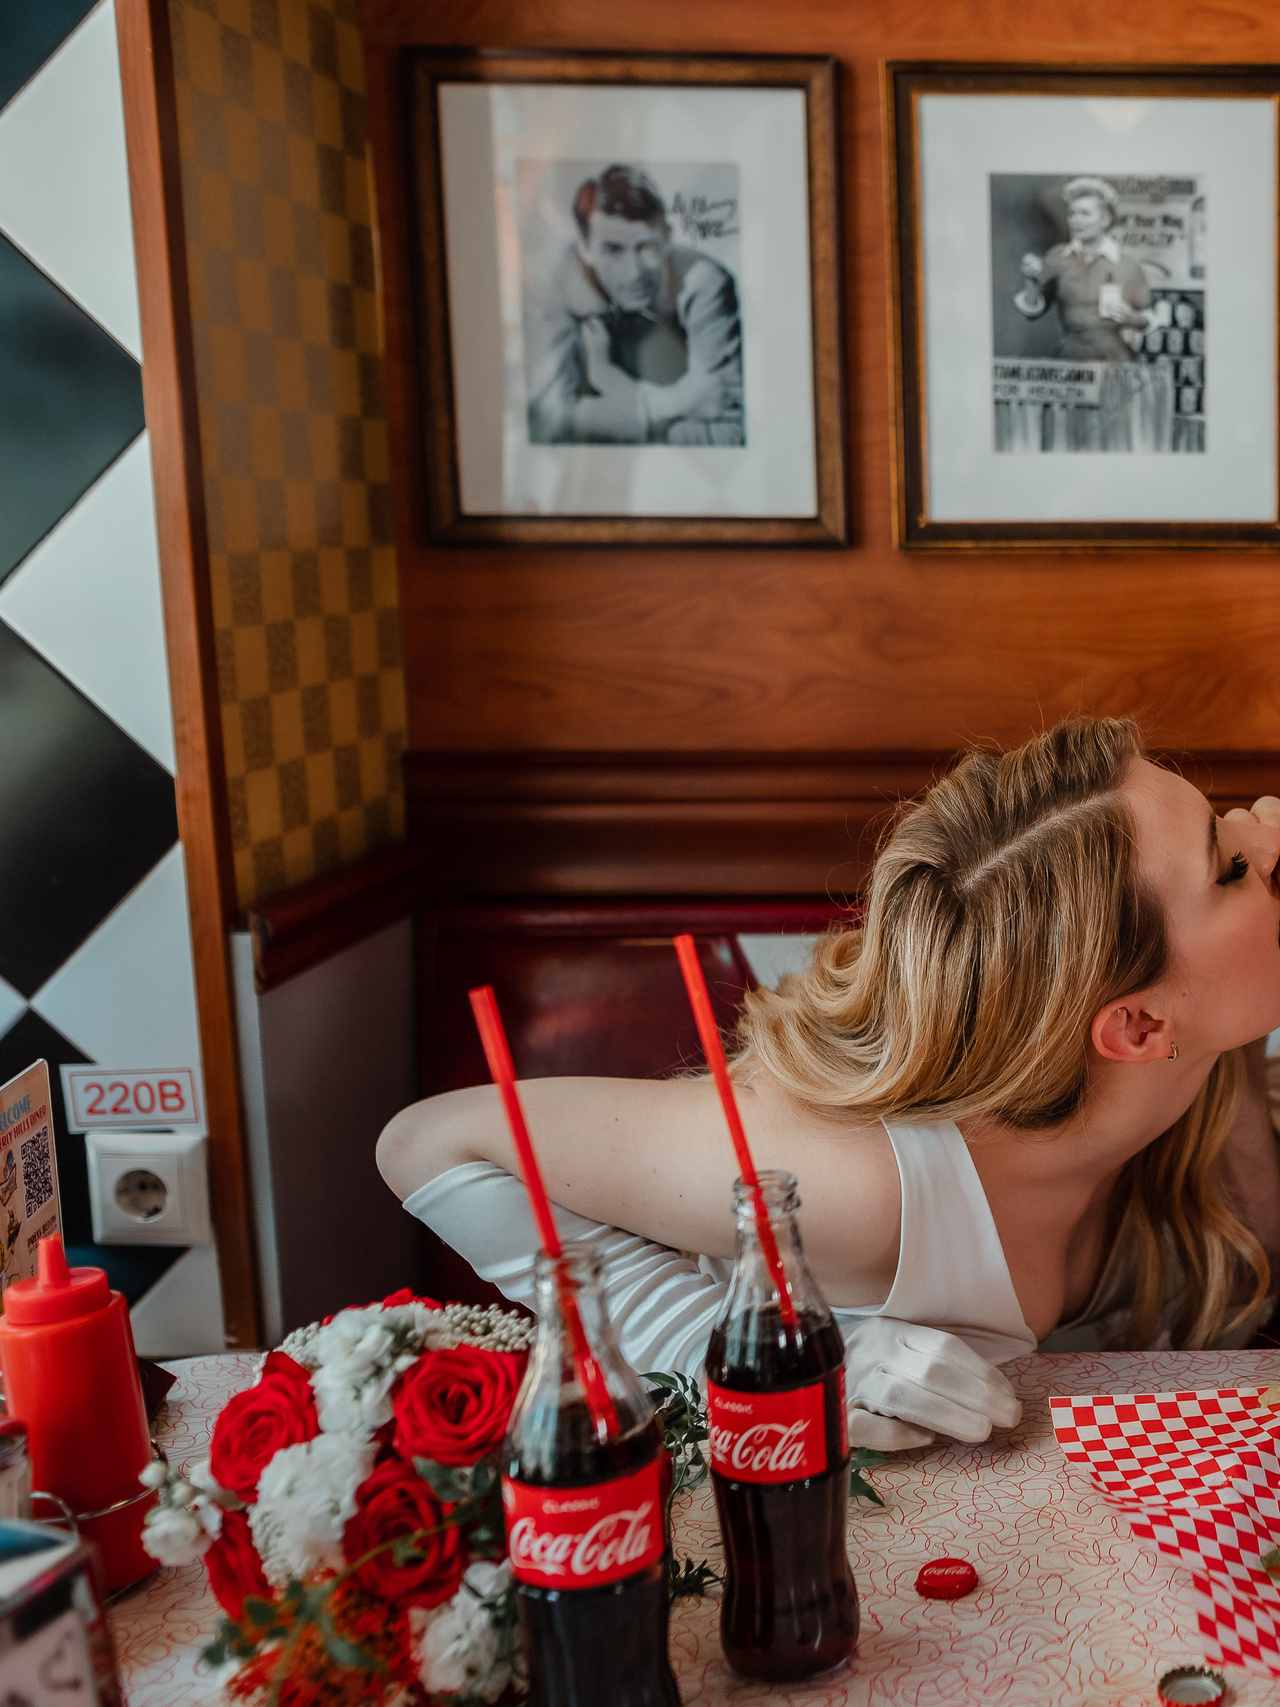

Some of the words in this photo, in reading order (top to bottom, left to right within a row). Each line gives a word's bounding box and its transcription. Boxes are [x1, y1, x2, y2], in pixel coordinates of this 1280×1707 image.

[0, 1093, 31, 1131] ELCOME
[13, 1117, 30, 1139] HILLS
[30, 1104, 46, 1126] DINER
[711, 1418, 811, 1473] ca-Cola
[509, 1500, 654, 1576] Coca-Cola
